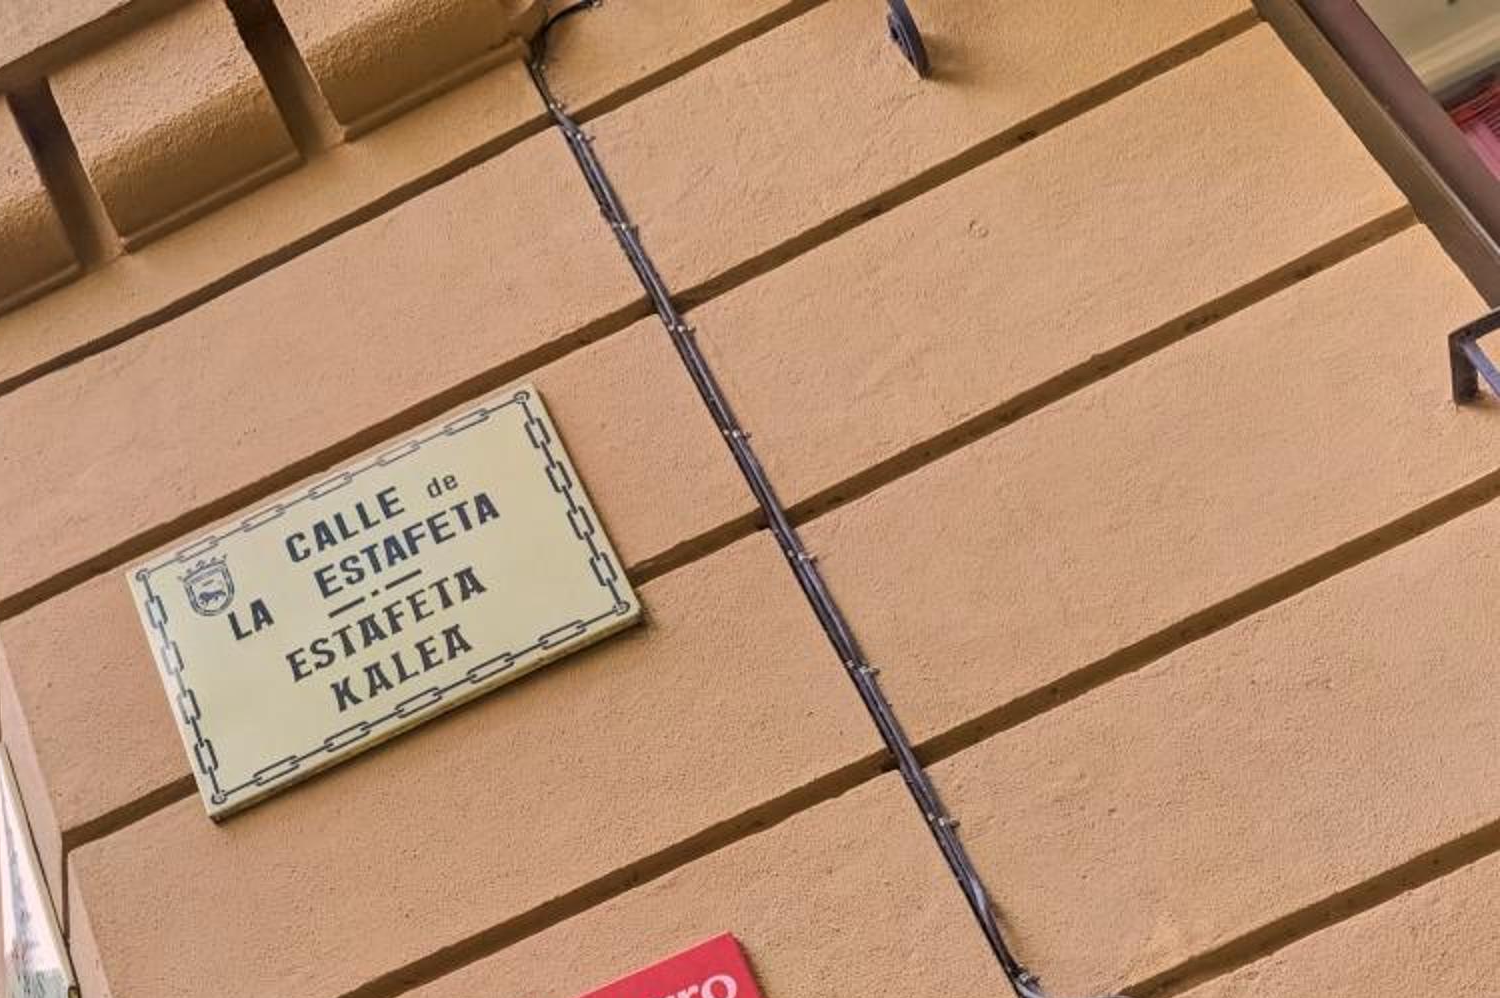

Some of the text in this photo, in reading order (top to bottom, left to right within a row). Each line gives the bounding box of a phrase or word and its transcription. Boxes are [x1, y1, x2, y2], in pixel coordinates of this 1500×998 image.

[228, 492, 501, 642] LA ESTAFETA
[285, 472, 459, 564] CALLE de
[286, 566, 488, 683] ESTAFETA
[330, 624, 474, 713] KALEA
